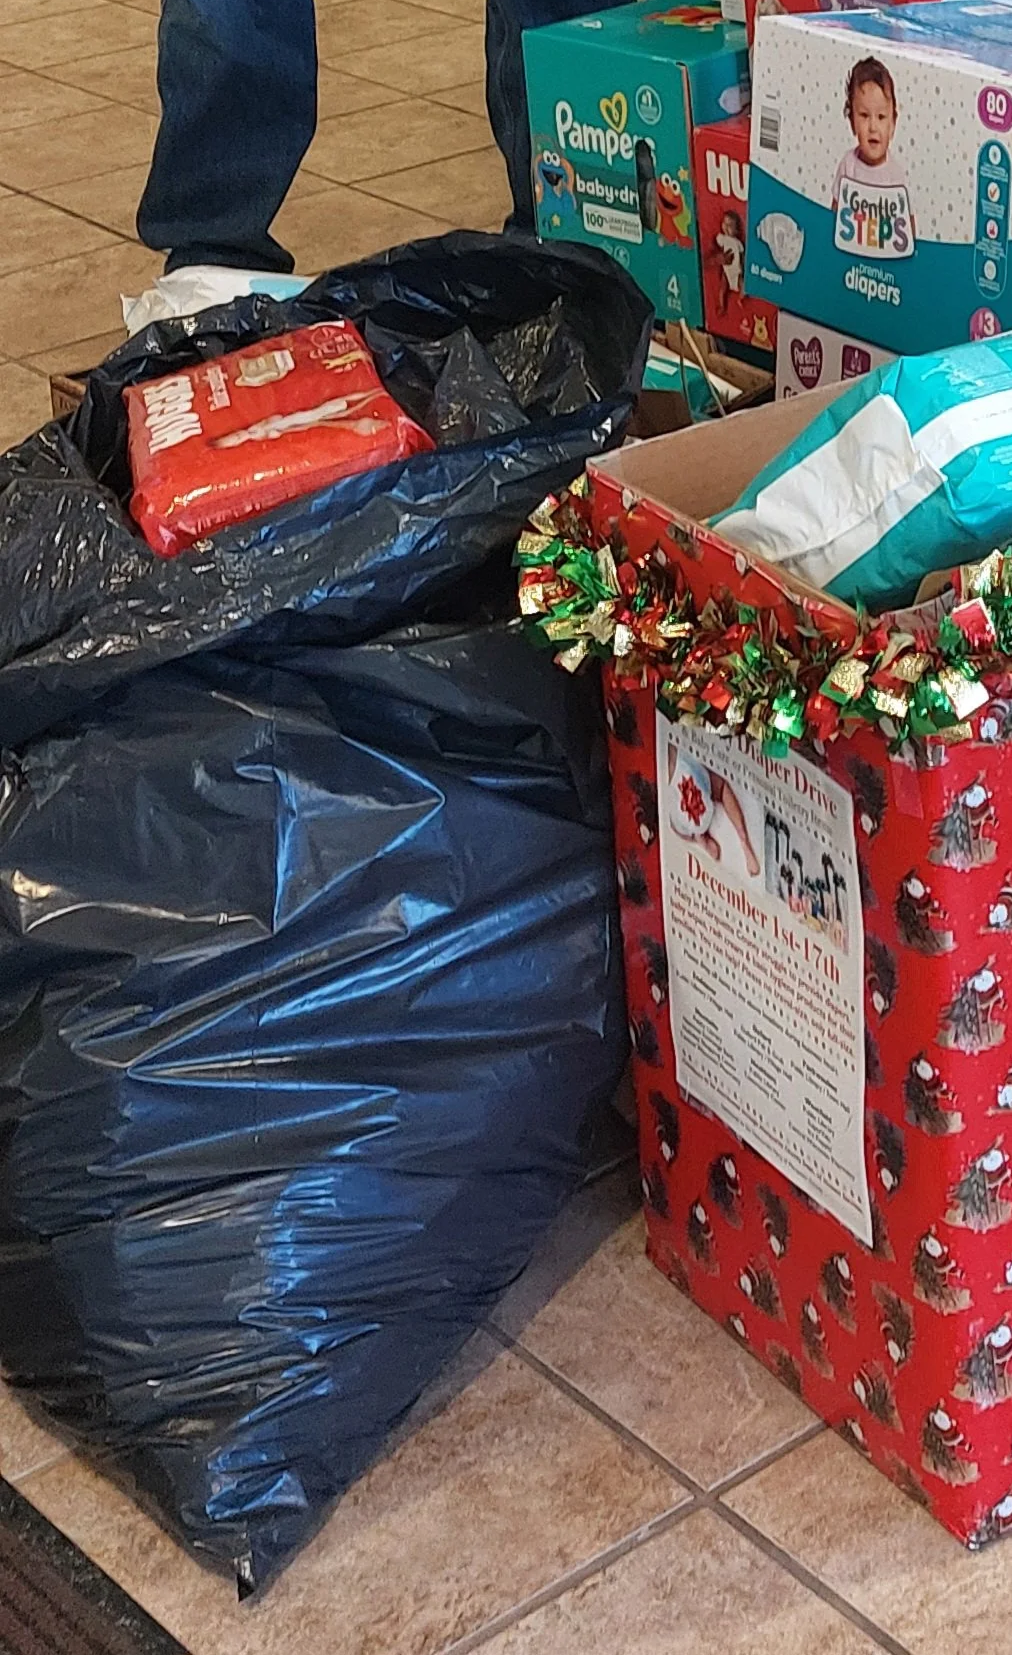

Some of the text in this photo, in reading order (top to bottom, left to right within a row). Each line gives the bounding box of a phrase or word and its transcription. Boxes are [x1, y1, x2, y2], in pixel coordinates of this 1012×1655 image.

[986, 91, 1007, 117] 80
[850, 192, 897, 219] Gentle
[839, 206, 908, 253] STEPS
[667, 273, 680, 297] 4
[844, 266, 901, 306] diapers
[859, 263, 895, 284] premium
[794, 347, 820, 365] Parent's
[691, 732, 709, 751] Baby
[711, 744, 729, 762] Care
[794, 765, 838, 820] Drive
[687, 851, 840, 985] December 1st-17th
